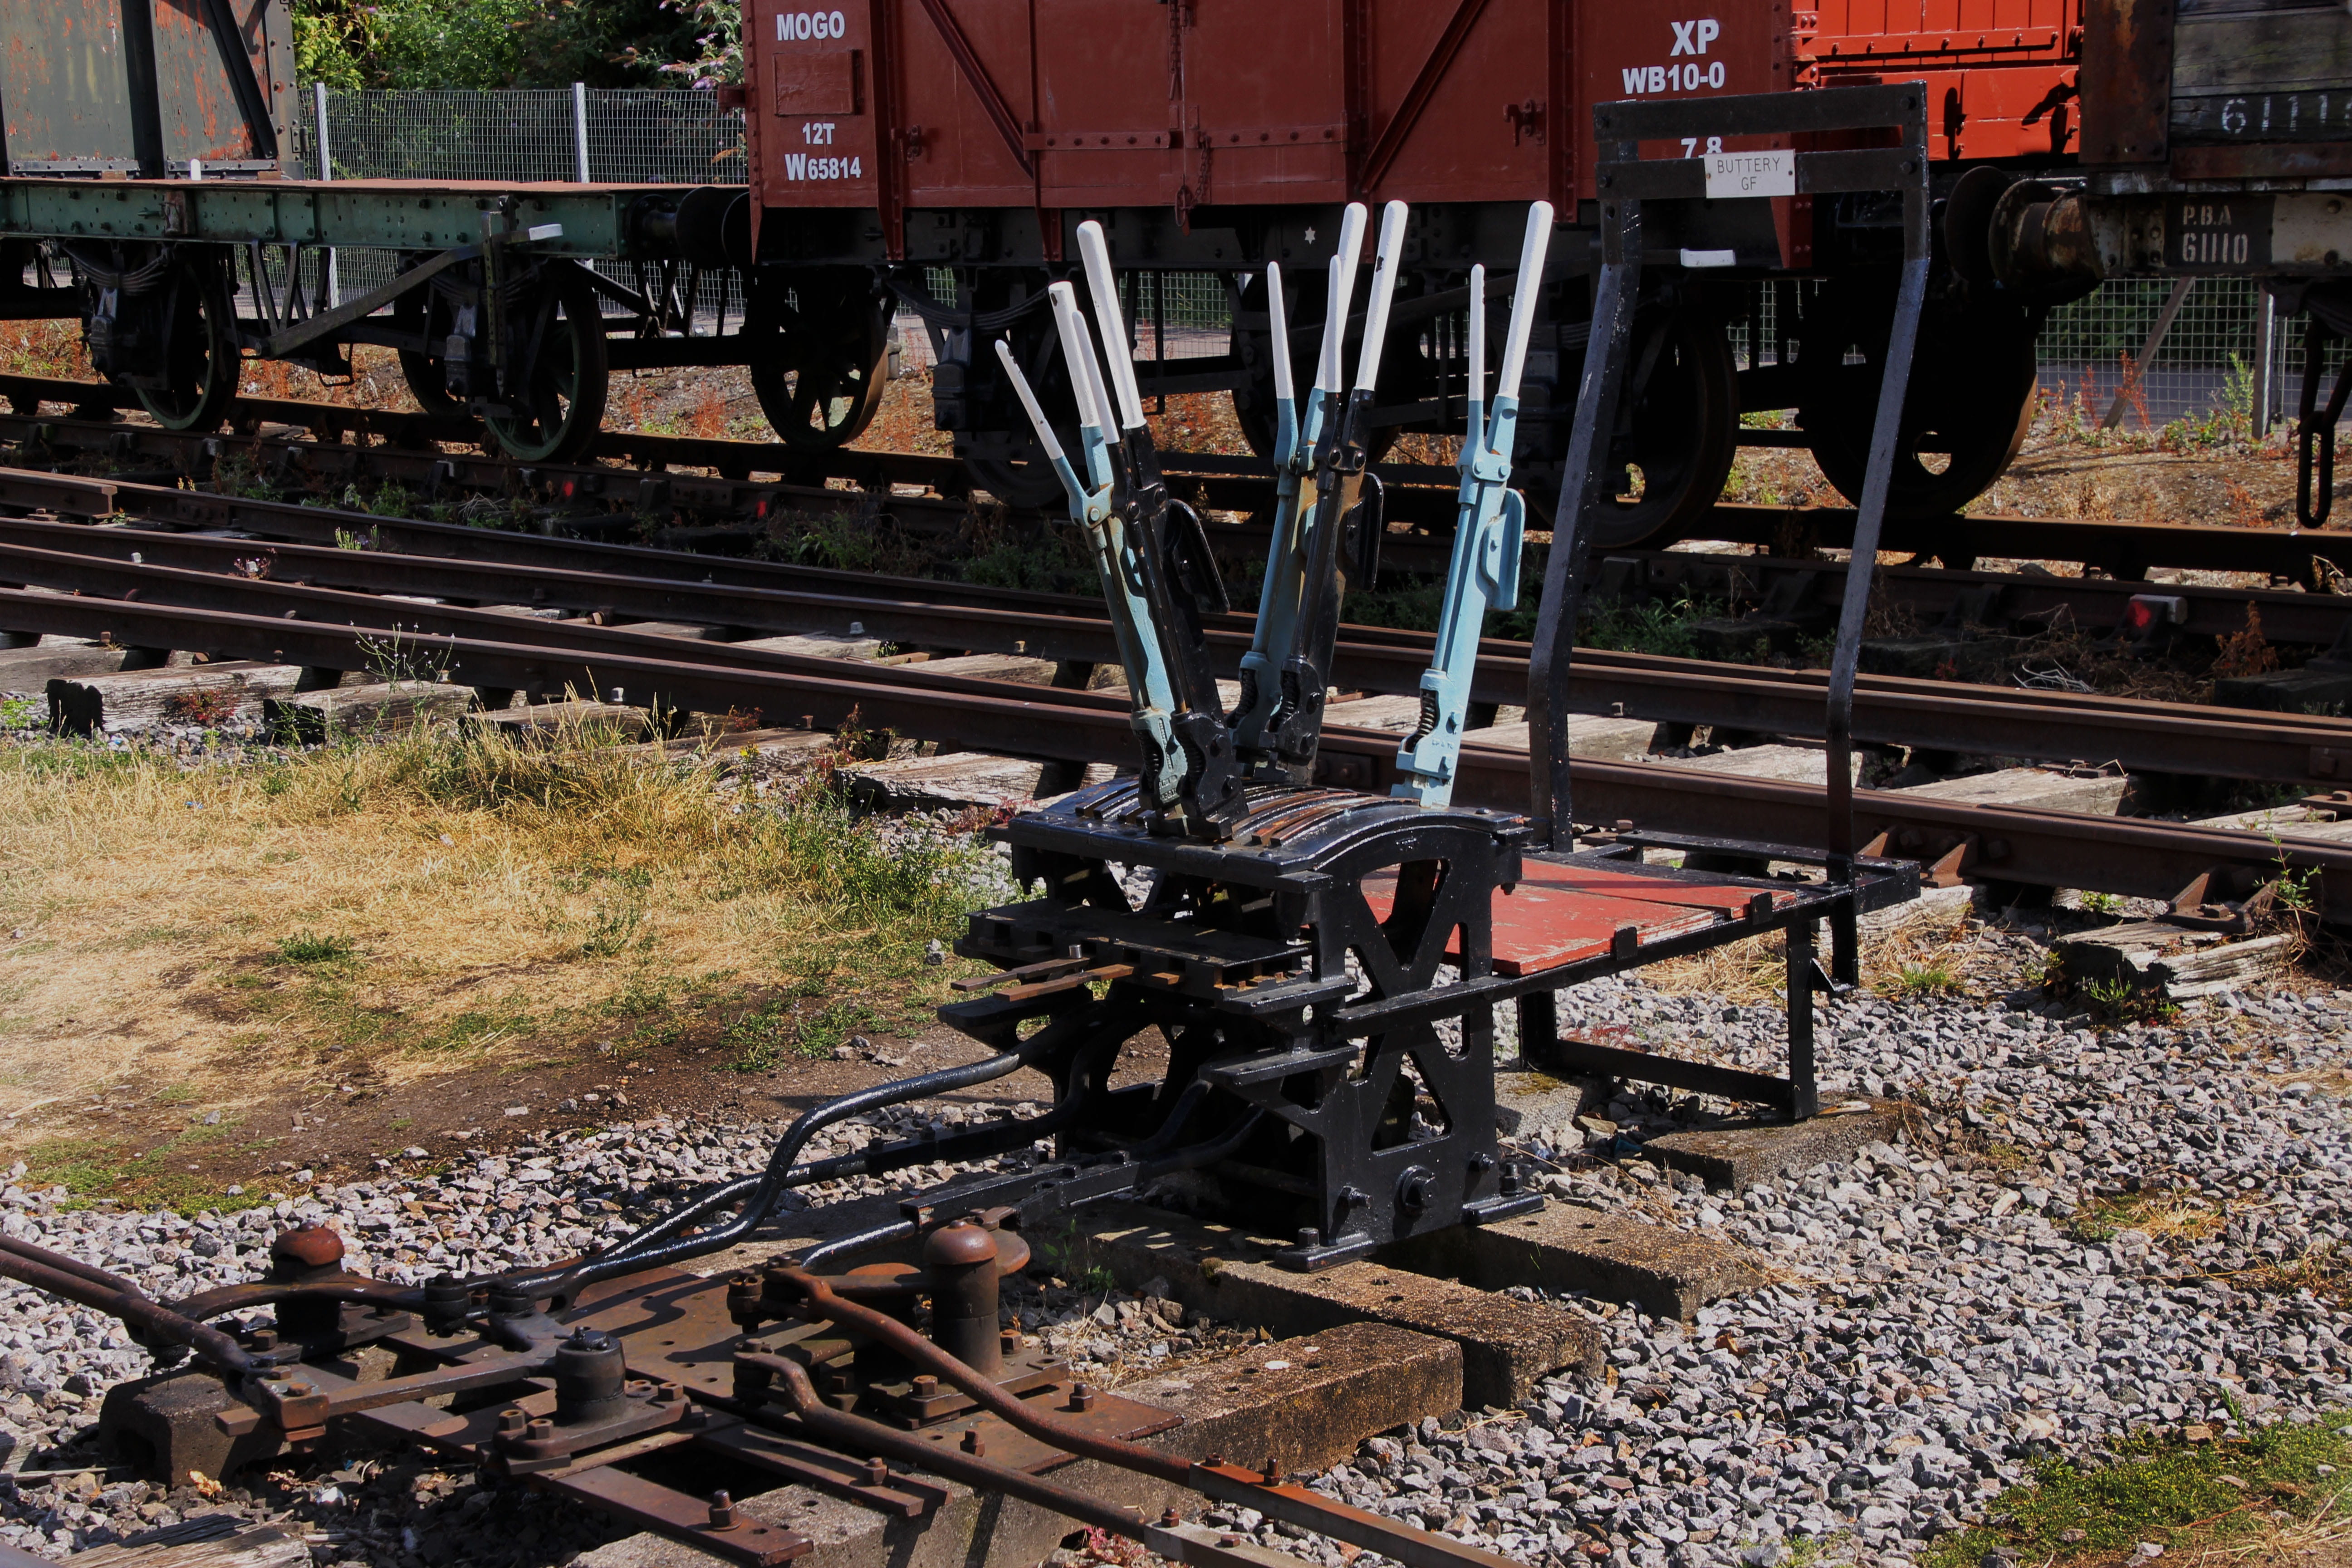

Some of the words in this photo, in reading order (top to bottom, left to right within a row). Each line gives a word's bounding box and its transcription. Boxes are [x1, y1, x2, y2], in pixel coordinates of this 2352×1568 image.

[776, 11, 845, 41] MOGO
[1670, 19, 1719, 56] XP
[1622, 61, 1725, 94] WB10-0
[803, 122, 835, 145] 12T
[1717, 157, 1780, 174] BUTTERY
[1741, 176, 1757, 191] GF
[2182, 233, 2248, 264] 61110
